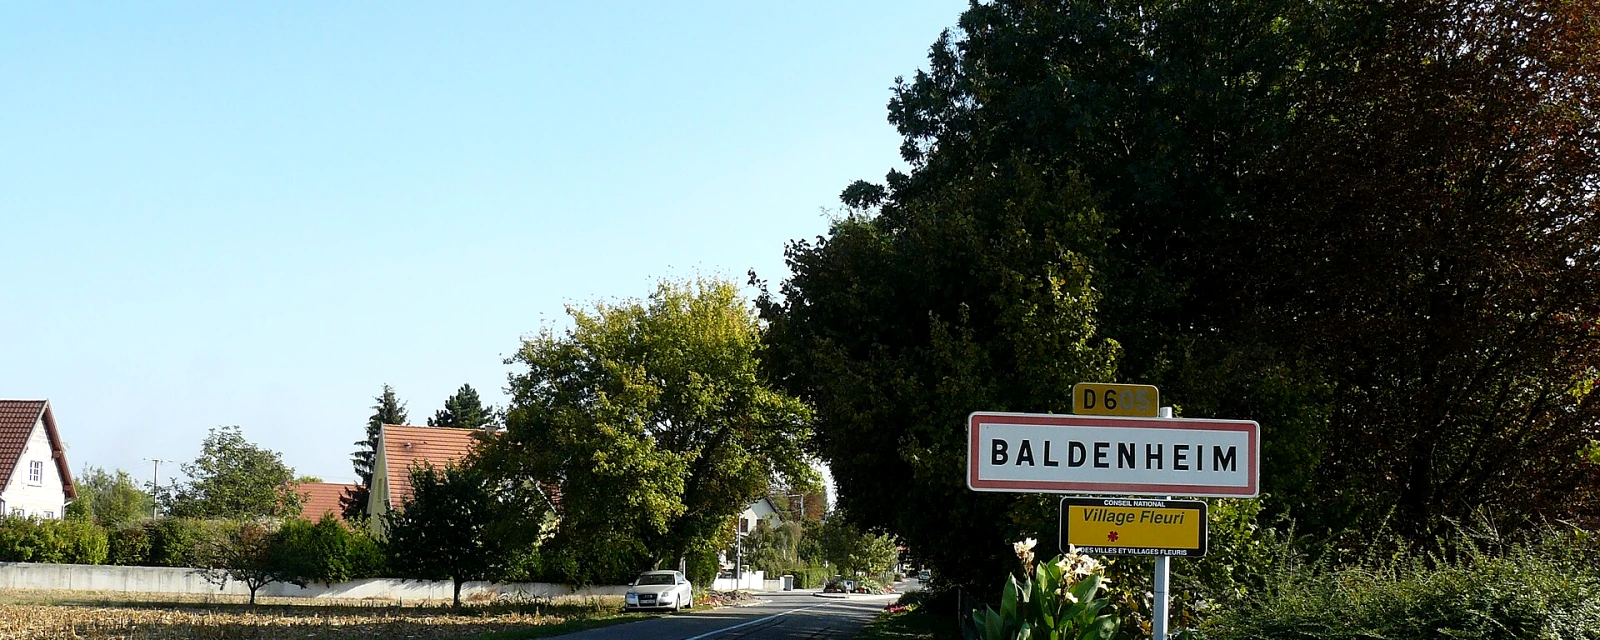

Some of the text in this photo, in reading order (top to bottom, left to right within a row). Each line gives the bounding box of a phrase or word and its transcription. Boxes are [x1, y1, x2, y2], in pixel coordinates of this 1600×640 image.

[1083, 388, 1149, 411] D 605
[991, 439, 1237, 472] BALDENHEIM
[1083, 508, 1185, 526] Village Fleuri
